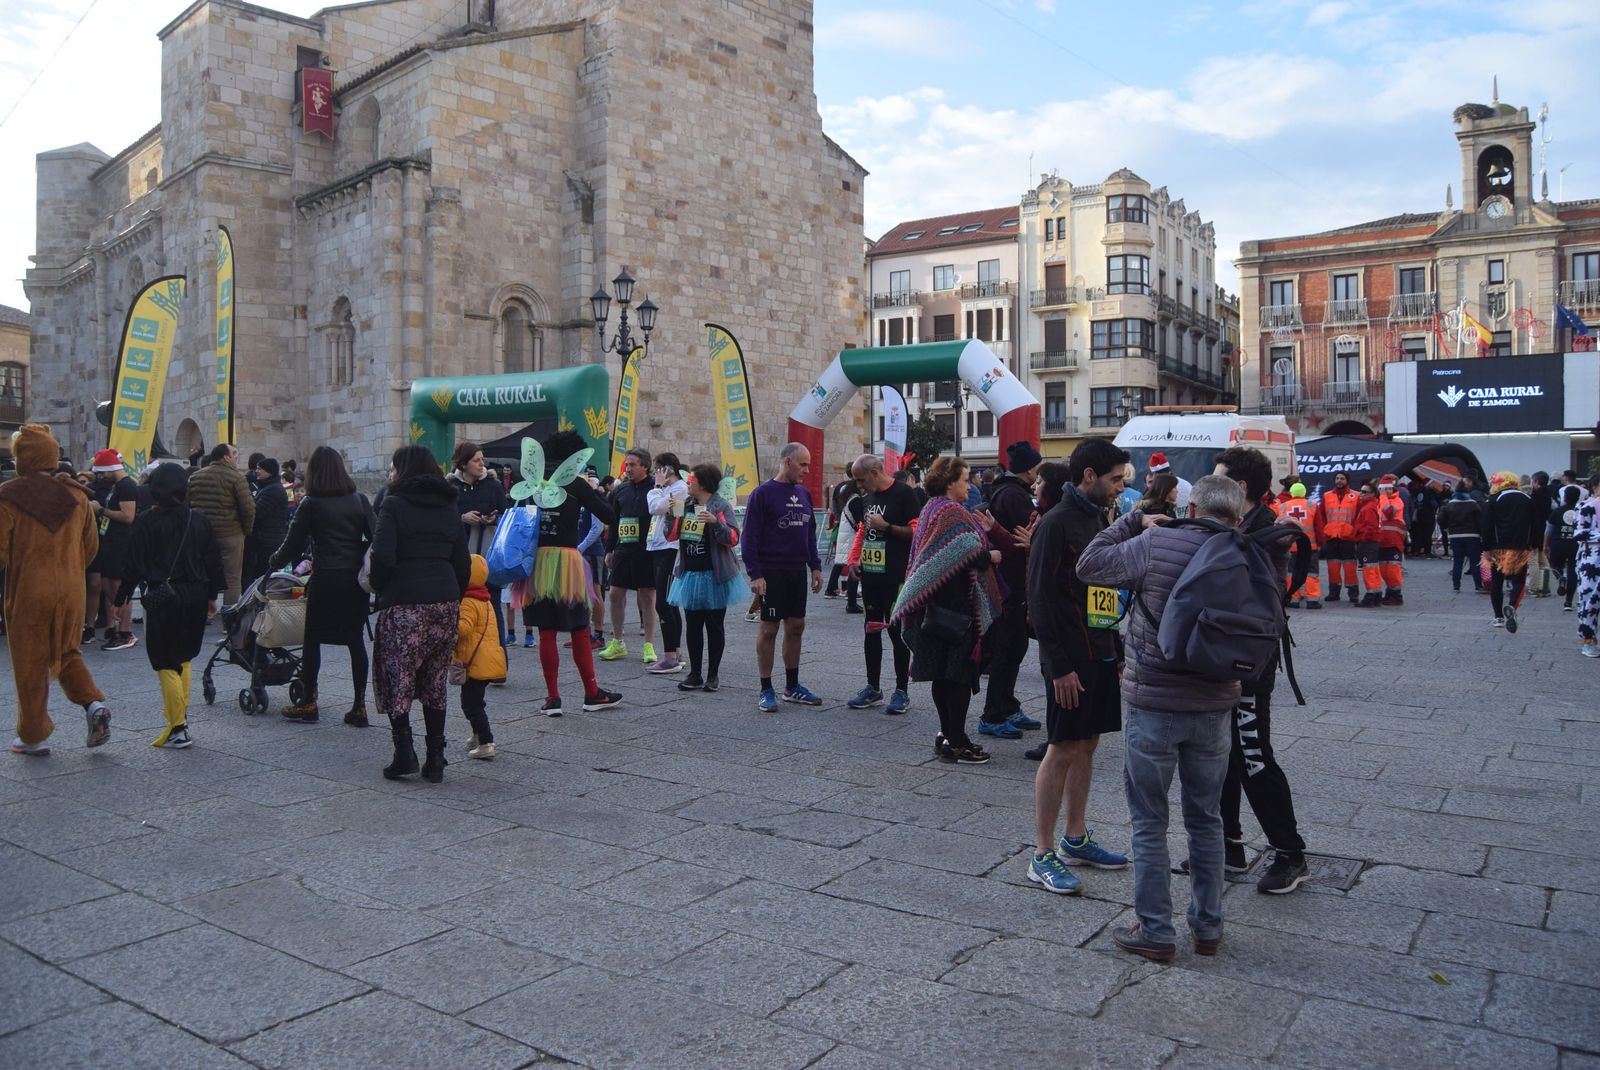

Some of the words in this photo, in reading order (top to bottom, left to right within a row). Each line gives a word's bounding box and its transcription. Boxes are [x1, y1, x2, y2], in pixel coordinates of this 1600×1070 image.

[457, 388, 491, 406] CAJA
[495, 384, 546, 405] RURAL
[1468, 387, 1498, 398] CAJA
[1501, 385, 1543, 397] RURAL
[1297, 462, 1371, 474] MORANA
[619, 525, 636, 536] 599
[684, 520, 698, 532] 36
[862, 549, 882, 563] 349
[1092, 589, 1115, 613] 1231
[1236, 693, 1266, 778] TALIA
